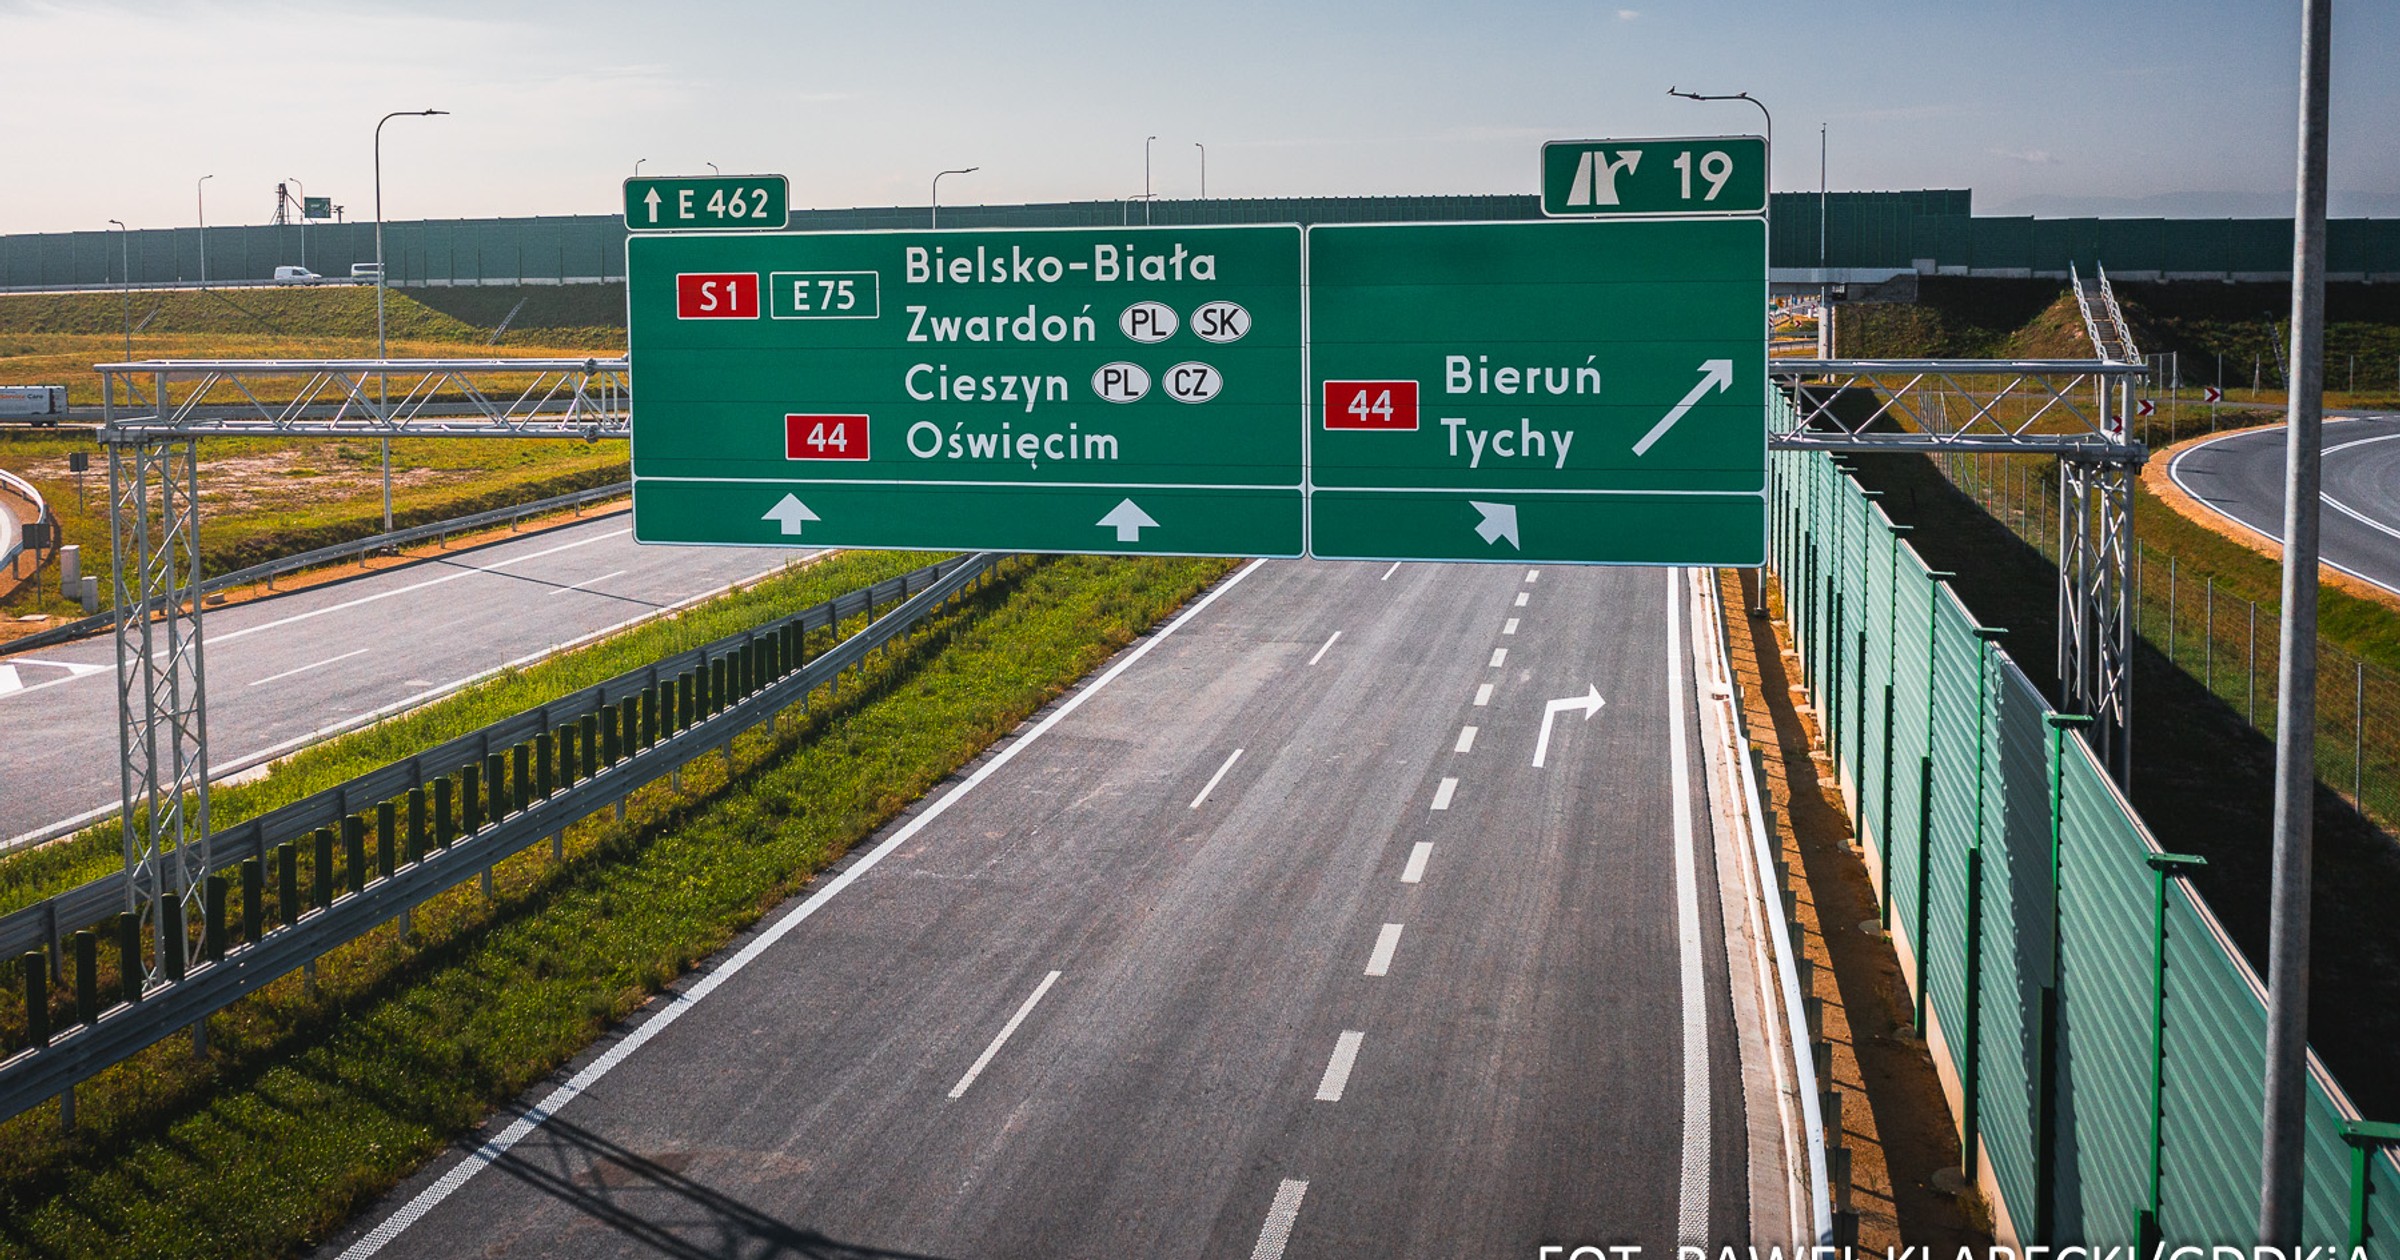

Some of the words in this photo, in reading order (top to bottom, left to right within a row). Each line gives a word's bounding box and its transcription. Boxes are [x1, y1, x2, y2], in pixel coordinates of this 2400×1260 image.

[1673, 150, 1733, 201] 19
[906, 243, 1216, 284] Bielsko-Biała
[906, 304, 1095, 342] Zwardoń
[1131, 308, 1167, 336] PL
[1201, 308, 1240, 336] SK
[905, 363, 1068, 413] Cieszyn
[1103, 368, 1139, 396] PL
[1174, 368, 1208, 396] CZ
[1446, 355, 1601, 395] Bieruń
[1348, 389, 1394, 422] 44
[807, 422, 848, 452] 44
[906, 420, 1118, 470] Oświęcim
[1440, 417, 1574, 469] Tychy
